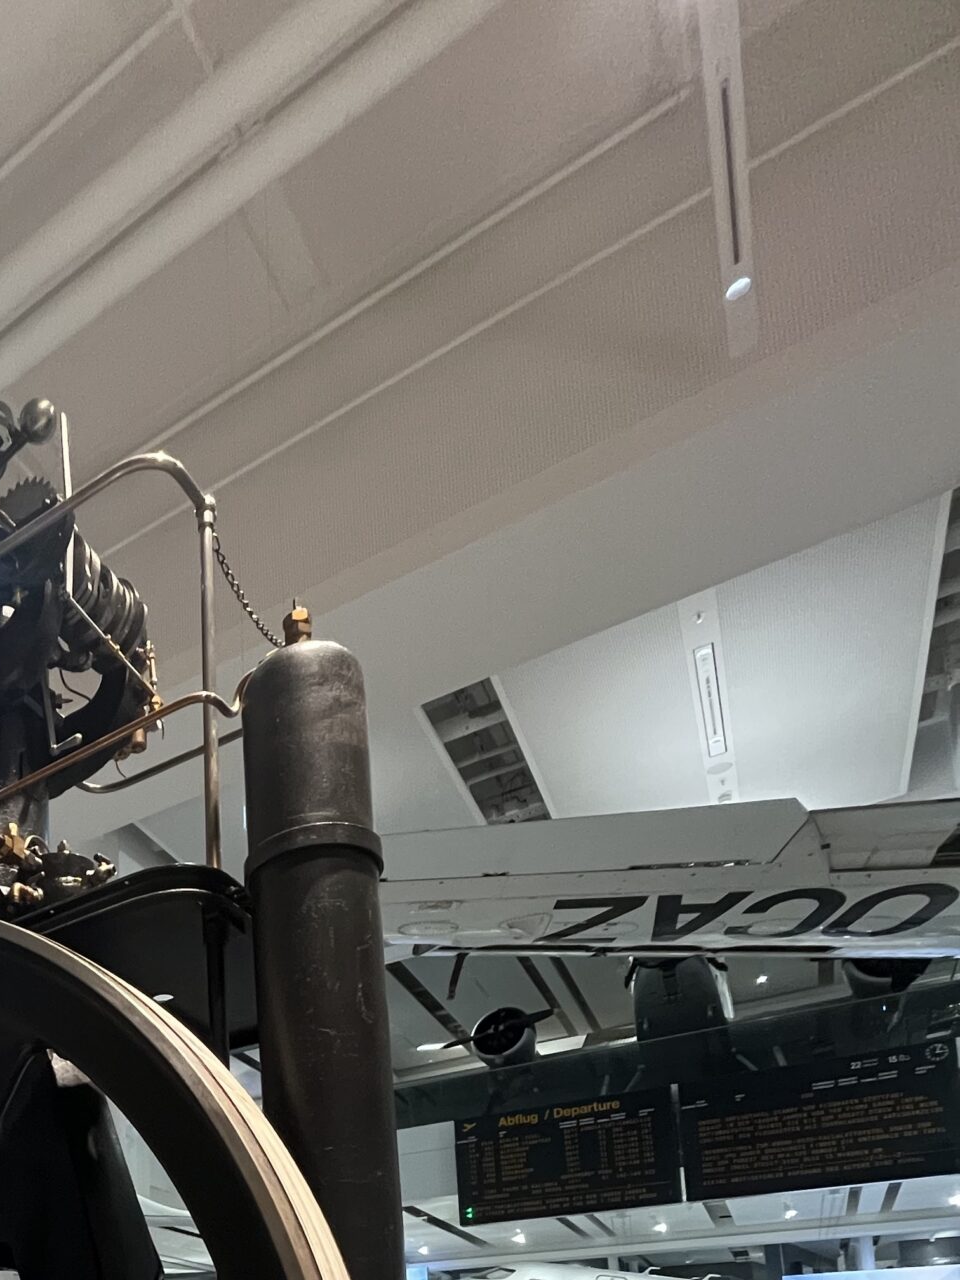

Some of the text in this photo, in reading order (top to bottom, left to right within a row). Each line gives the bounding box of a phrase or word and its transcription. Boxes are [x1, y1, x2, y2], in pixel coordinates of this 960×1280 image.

[532, 883, 959, 943] OCAZ
[498, 1112, 538, 1127] Abflug
[544, 1109, 551, 1121] /
[553, 1100, 621, 1119] Departure
